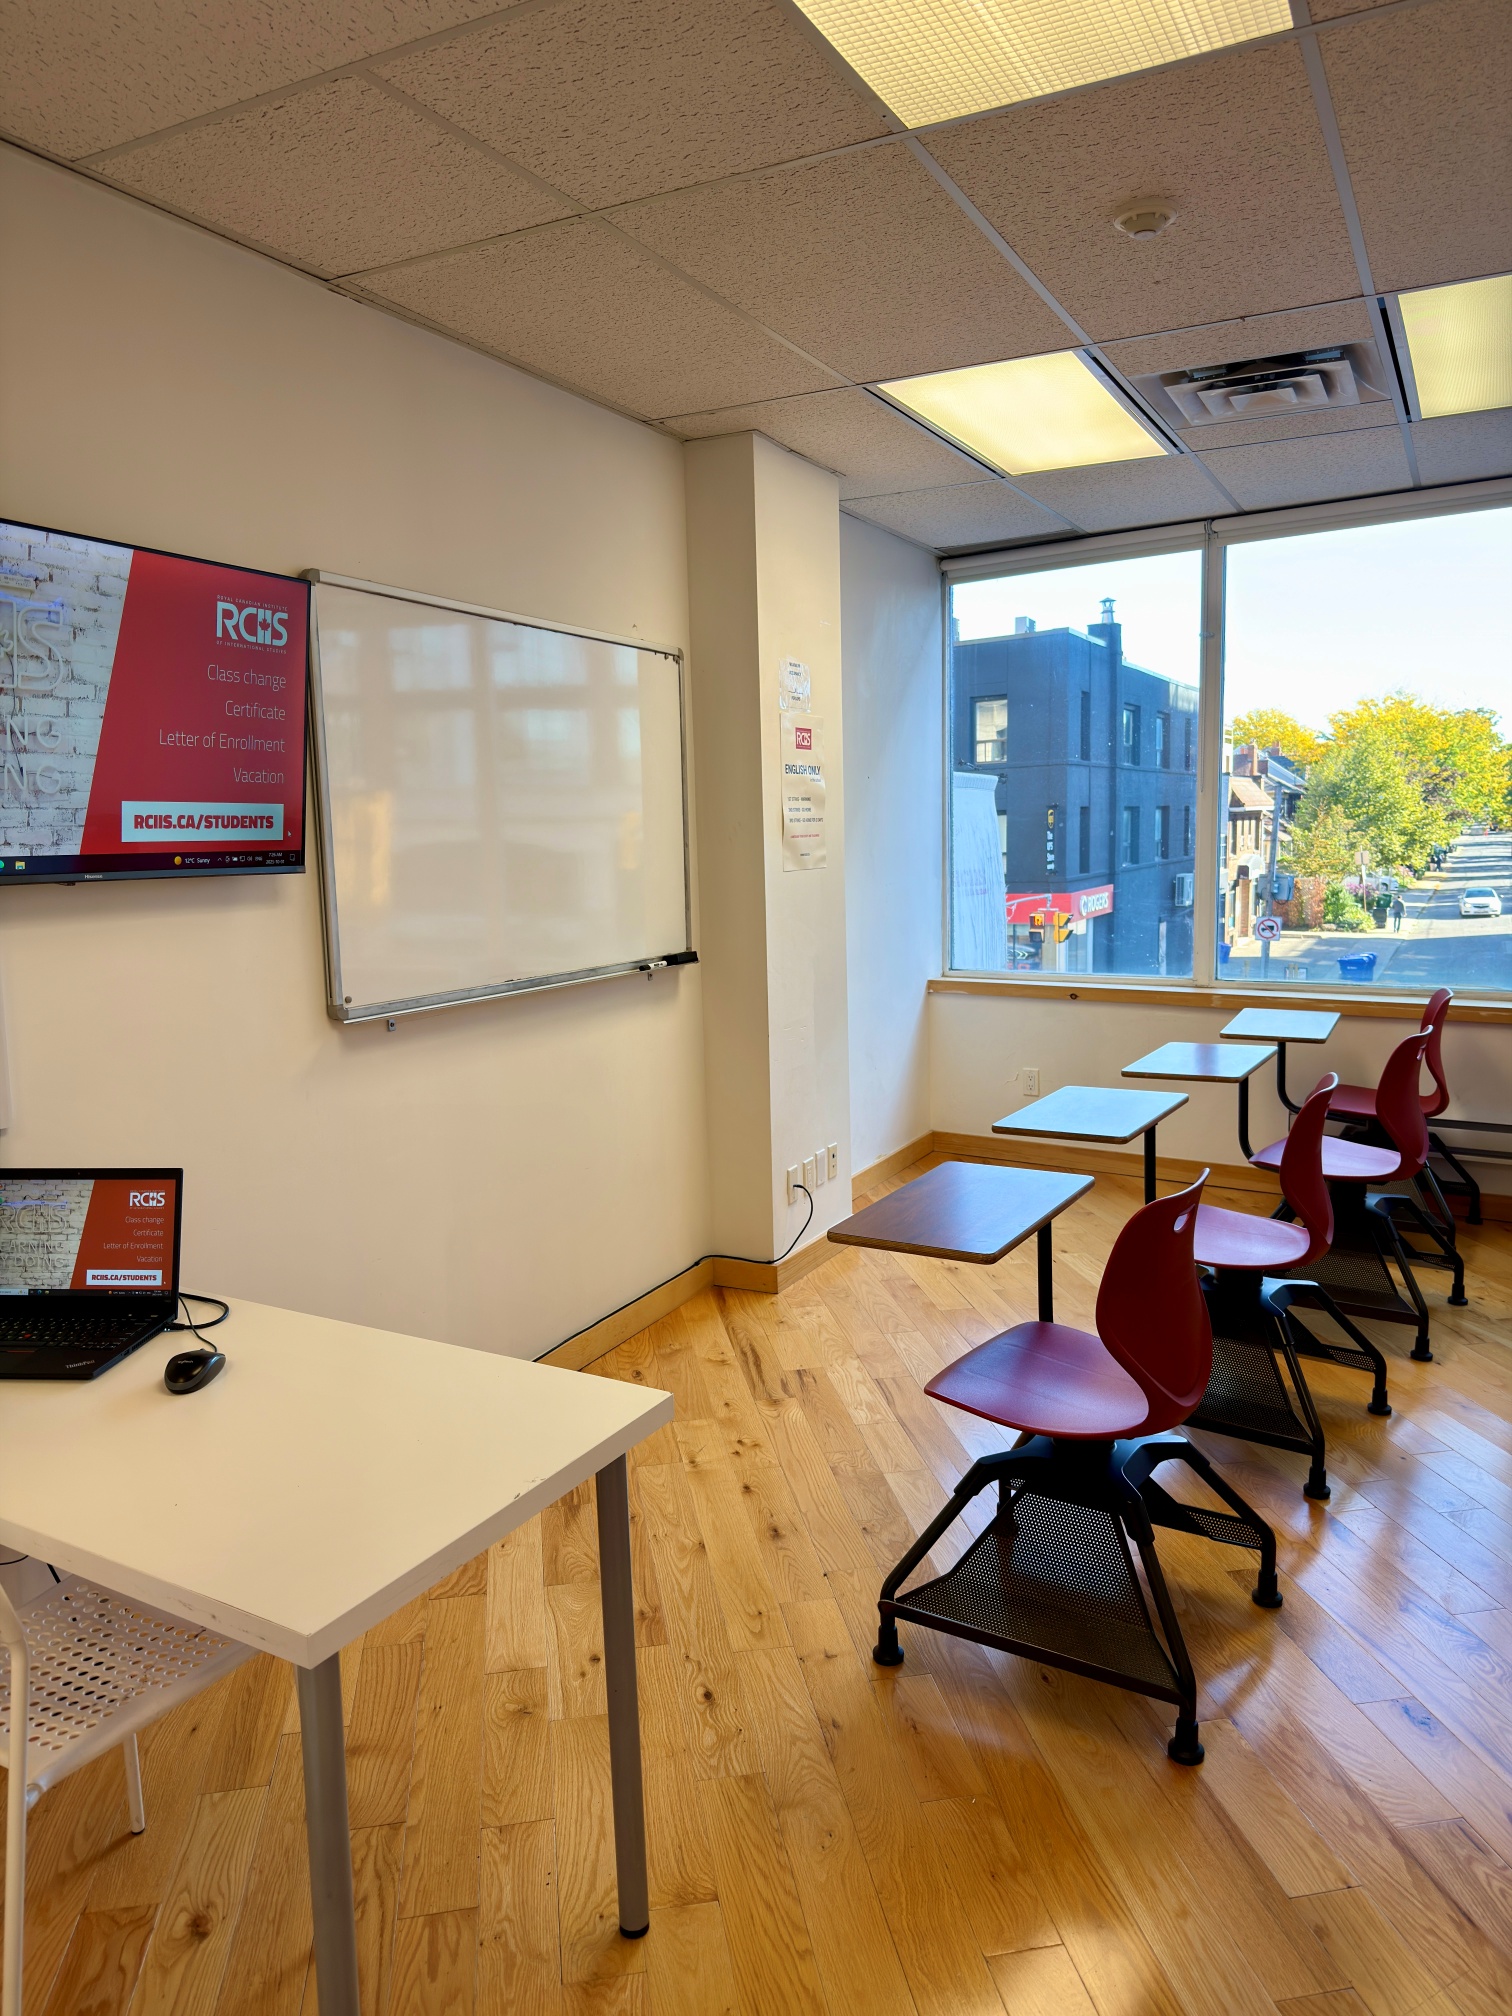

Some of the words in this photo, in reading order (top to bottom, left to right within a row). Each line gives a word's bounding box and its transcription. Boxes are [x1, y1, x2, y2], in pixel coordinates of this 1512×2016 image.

[216, 594, 233, 602] ROYAL
[224, 641, 265, 651] INTERNATIONAL
[207, 664, 241, 683] Class
[243, 669, 287, 692] change
[225, 700, 287, 721] Certificate
[159, 728, 200, 747] Letter
[202, 731, 217, 748] of
[219, 733, 286, 753] Enrollment
[785, 764, 807, 775] ENGLISH
[808, 765, 821, 775] ONLY
[233, 767, 284, 784] Vacation
[133, 814, 274, 831] RCIIS.CA/STUDENTS
[1087, 892, 1109, 913] ROGERS
[125, 1216, 142, 1224] Class
[142, 1216, 165, 1225] change
[133, 1228, 164, 1237] Certificate
[103, 1242, 122, 1250] Letter
[122, 1242, 129, 1250] of
[130, 1242, 164, 1250] Enrollment
[136, 1255, 163, 1263] Vacation
[91, 1274, 158, 1282] RCIIS.CA/STUDENTS
